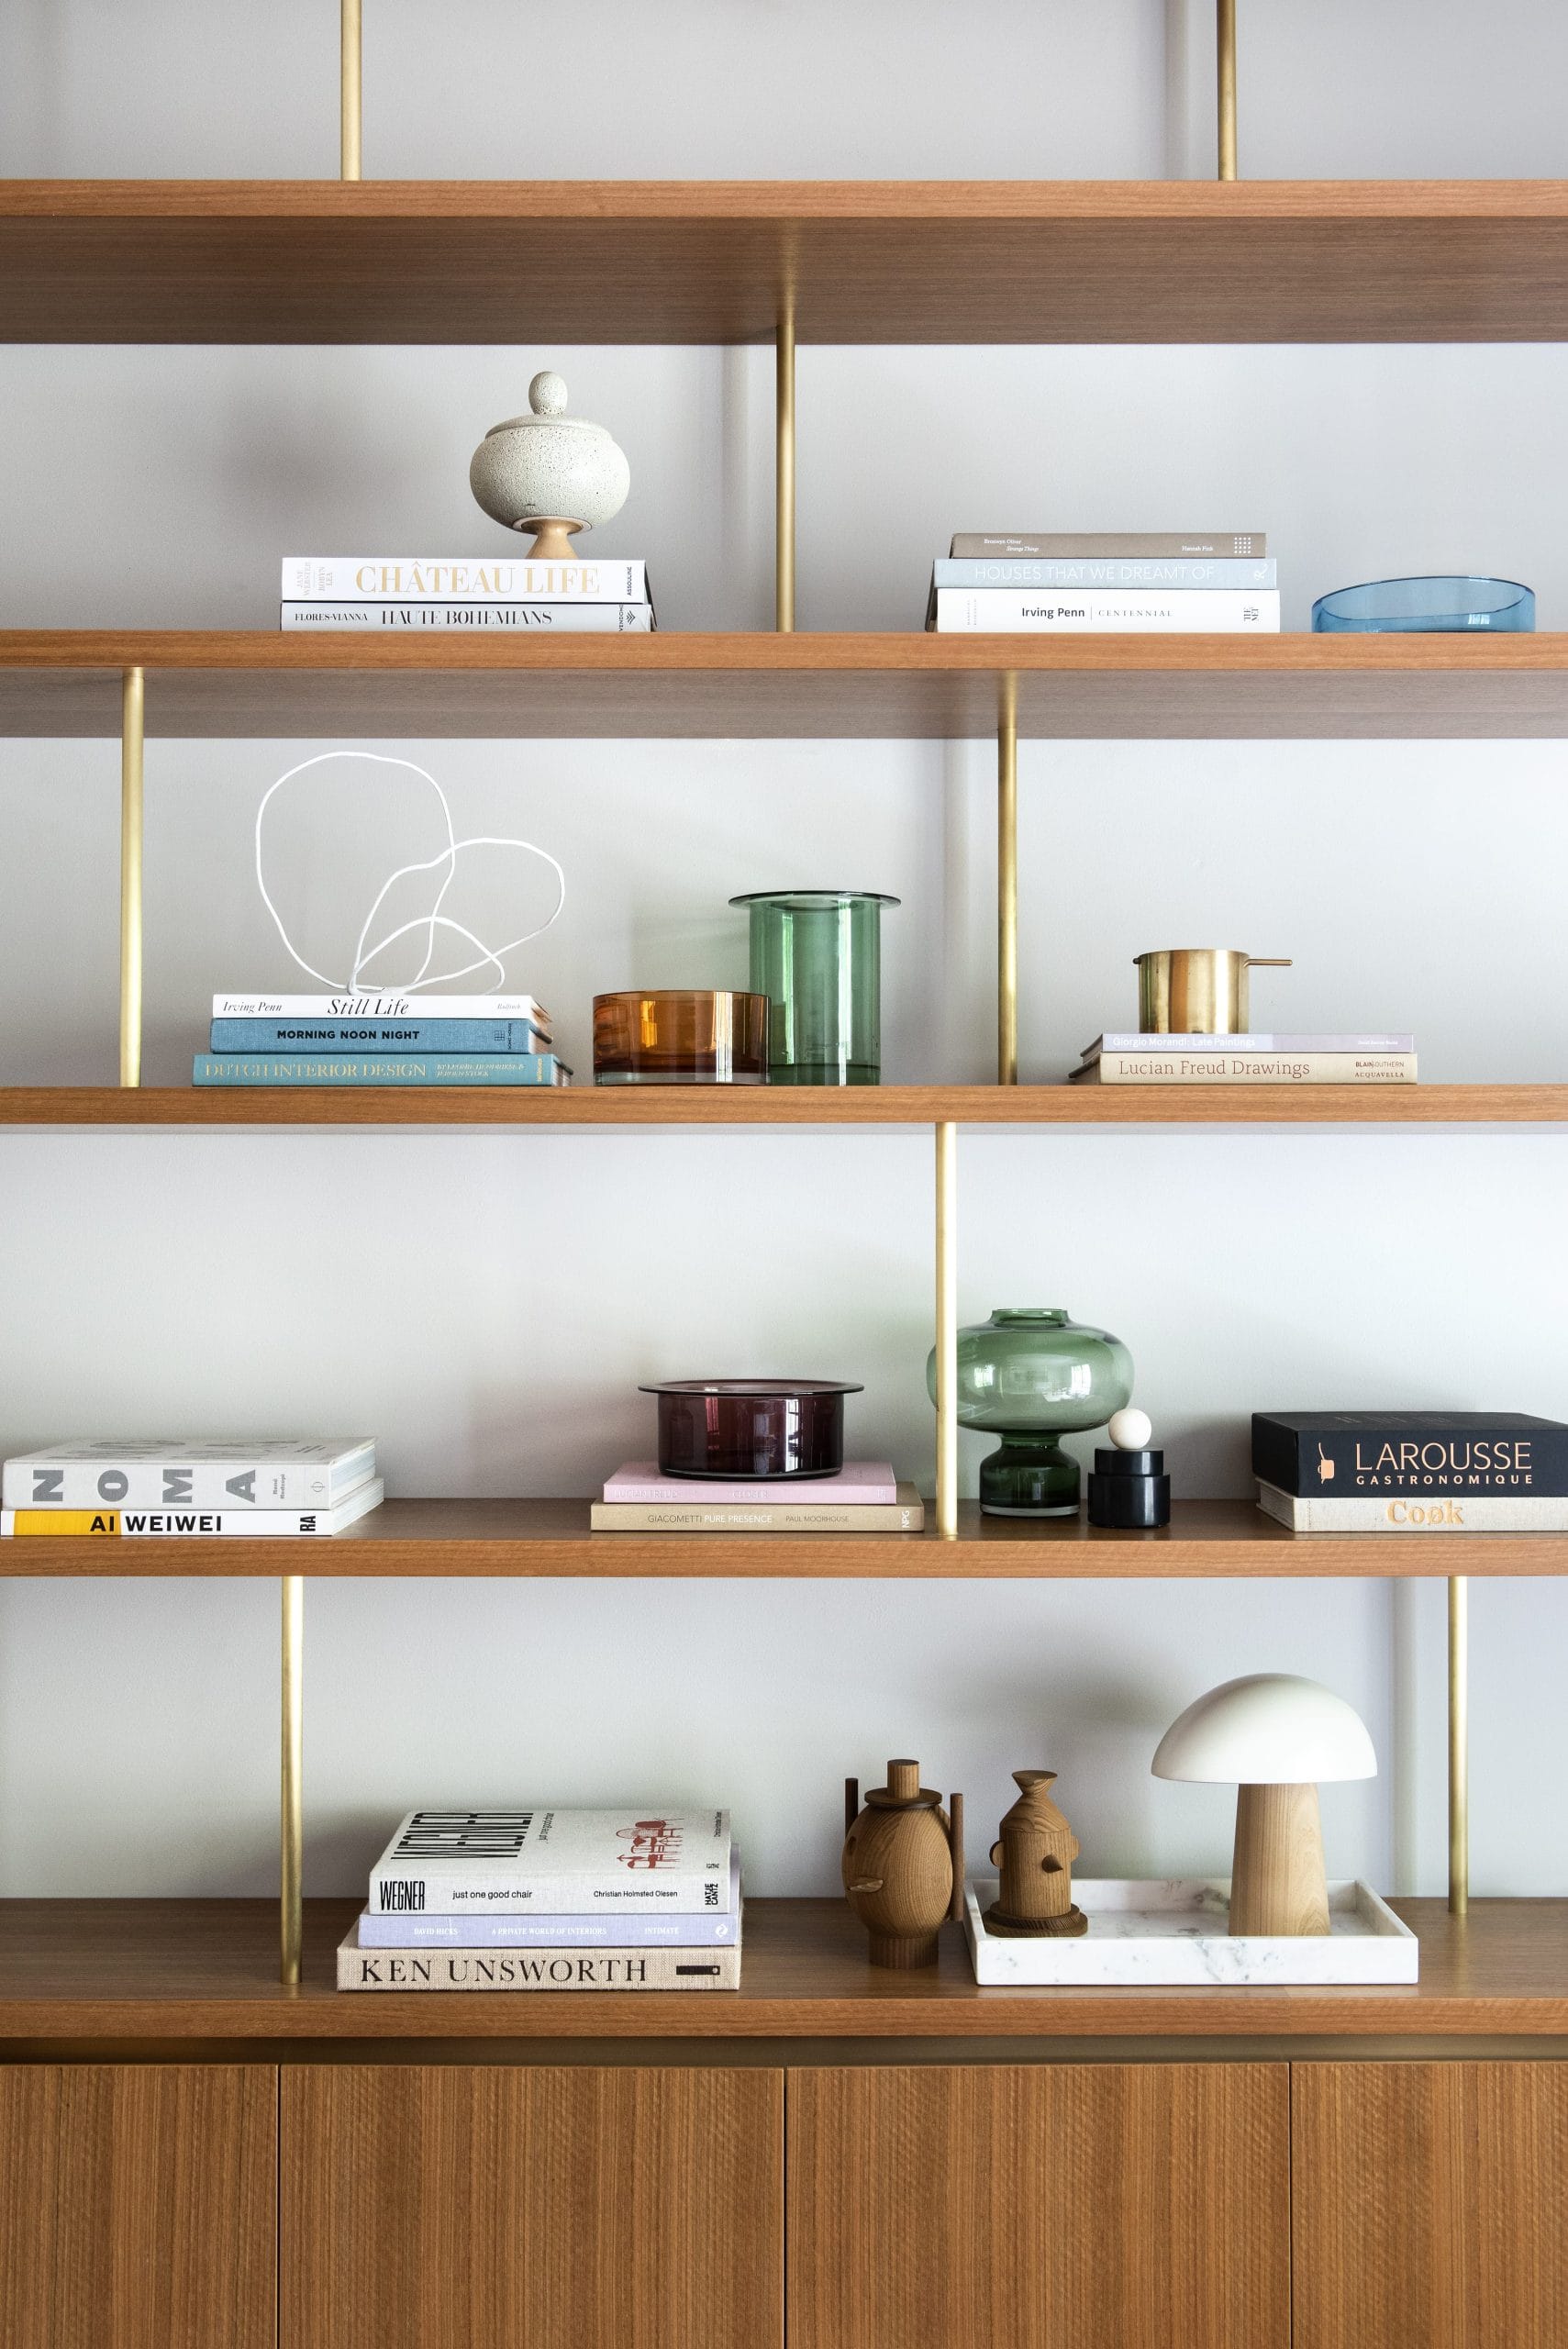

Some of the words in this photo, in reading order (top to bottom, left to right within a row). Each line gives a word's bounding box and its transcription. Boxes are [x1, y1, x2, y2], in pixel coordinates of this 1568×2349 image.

[356, 561, 516, 594] CHÂTEAU
[523, 567, 600, 594] LIFE
[974, 566, 1042, 580] HOUSES
[1046, 566, 1086, 580] THAT
[1090, 566, 1116, 580] WE
[1121, 566, 1188, 580] DREAMT
[1192, 566, 1216, 580] OF
[295, 613, 368, 621] FLORES-VIANNA
[382, 610, 441, 624] HAUTE
[447, 610, 552, 624] BOHEMIANS
[1021, 607, 1054, 619] Irving
[1057, 607, 1085, 617] Penn
[223, 1001, 255, 1013] Irving
[257, 1001, 283, 1011] Penn
[326, 998, 370, 1015] Still
[373, 998, 409, 1016] Life
[277, 1030, 336, 1040] MORNING
[339, 1030, 377, 1040] NOON
[382, 1030, 420, 1040] NIGHT
[1113, 1037, 1147, 1048] Giorgio
[1148, 1037, 1190, 1046] Morandi:
[1192, 1037, 1212, 1046] Late
[1214, 1037, 1256, 1048] Paintings
[206, 1063, 269, 1077] DUTCH
[274, 1063, 358, 1077] INTERIOR
[363, 1063, 427, 1077] DESIGN
[1119, 1060, 1174, 1074] Lucian
[1180, 1060, 1227, 1074] Freud
[1231, 1060, 1310, 1078] Drawings
[1355, 1442, 1532, 1470] LAROUSSE
[1356, 1475, 1533, 1485] GASTRONOMIQUE
[90, 1516, 115, 1531] AI
[125, 1516, 221, 1531] WEIWEI
[300, 1516, 316, 1531] RA
[647, 1515, 702, 1523] GIACOMETTI
[704, 1515, 726, 1523] PURE
[728, 1515, 773, 1523] PRESENCE
[902, 1510, 910, 1528] NPG
[391, 1812, 533, 1859] WEGNER
[380, 1881, 425, 1910] WEGNER
[452, 1890, 468, 1899] just
[488, 1890, 509, 1899] good
[511, 1890, 532, 1898] chair
[361, 1959, 431, 1982] KEN
[448, 1959, 646, 1982] UNSWORTH
